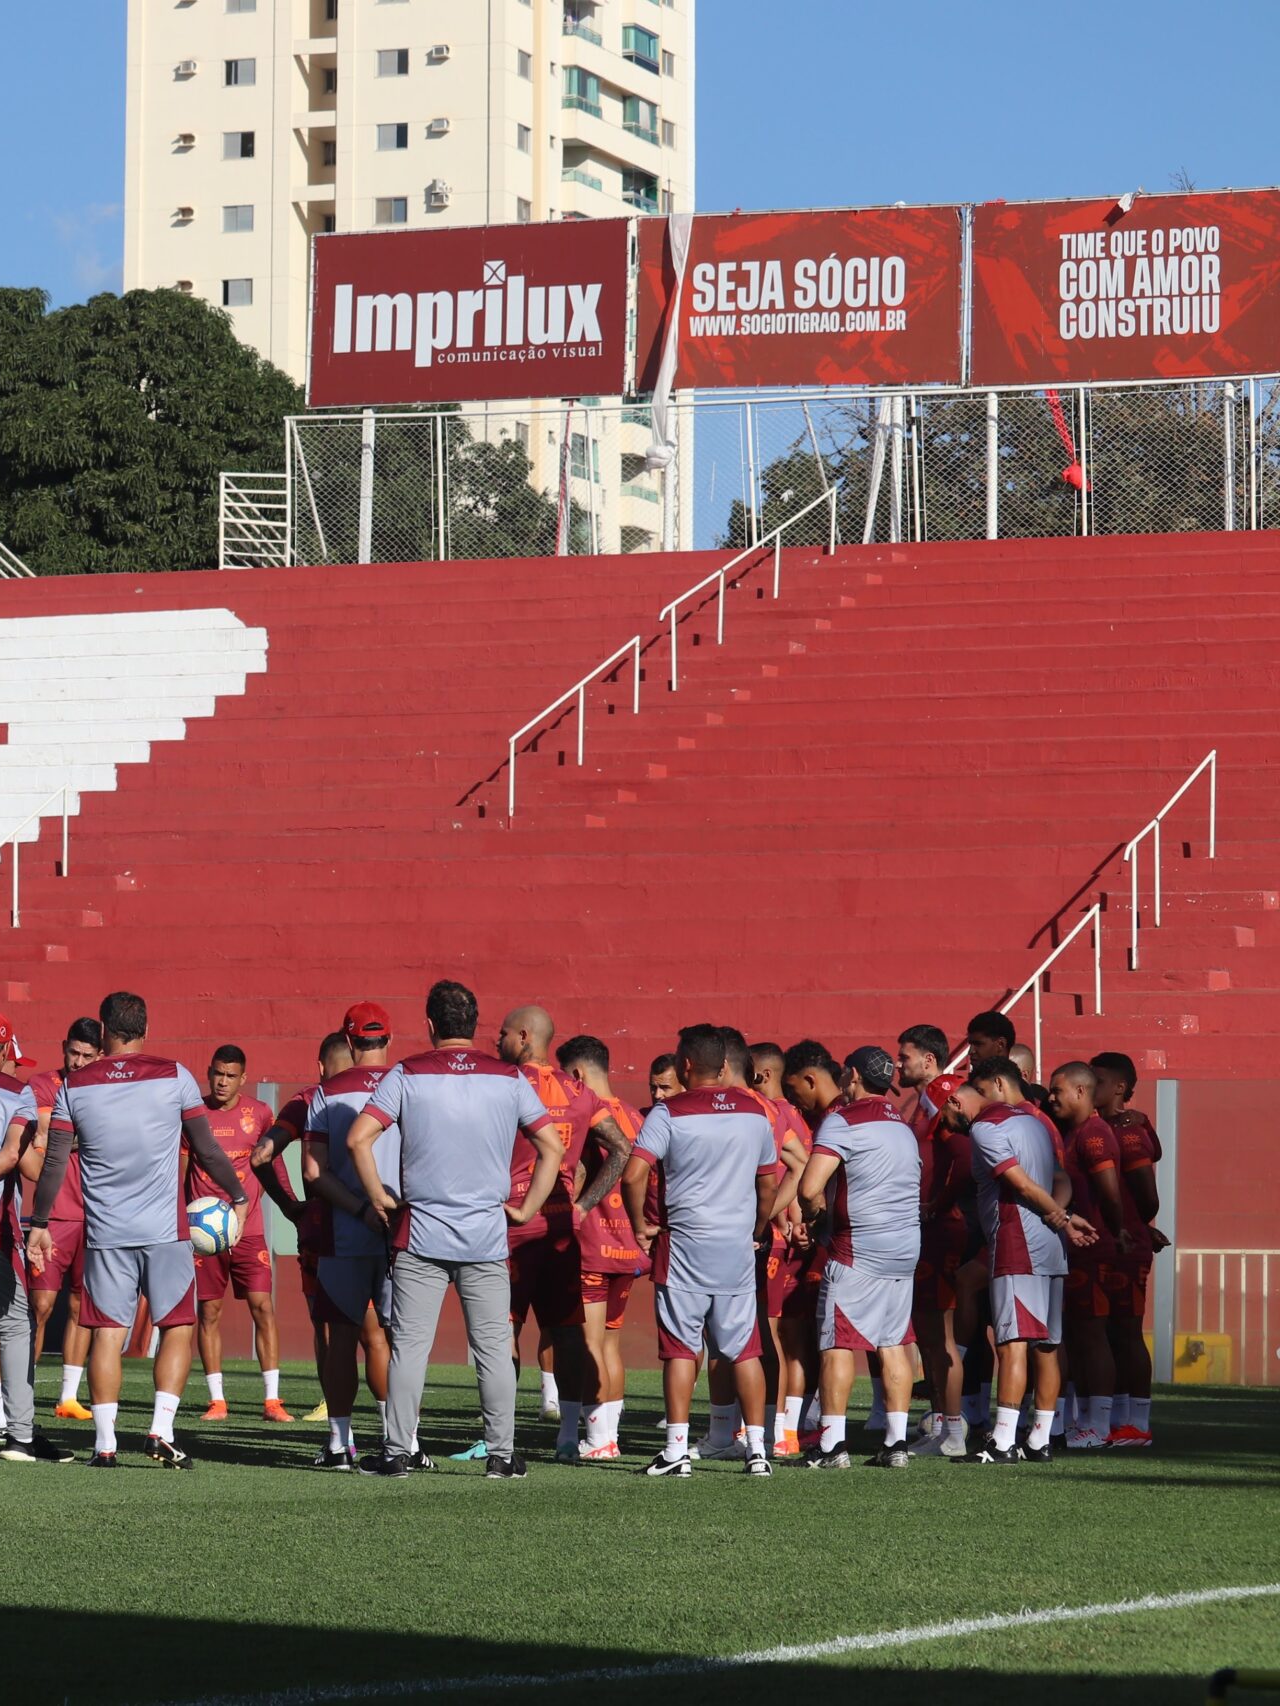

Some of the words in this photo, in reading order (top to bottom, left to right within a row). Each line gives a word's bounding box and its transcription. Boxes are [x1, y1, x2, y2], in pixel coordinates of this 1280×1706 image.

[1059, 232, 1106, 260] TIME
[1110, 230, 1147, 259] QUE
[1151, 229, 1164, 255] O
[1169, 226, 1219, 254] POVO
[692, 260, 785, 312] SEJA
[793, 252, 906, 309] SÓCIO
[1059, 258, 1125, 300] COM
[1132, 254, 1220, 297] AMOR
[333, 260, 602, 367] Imprilux
[689, 310, 906, 337] WWW.SOCIOTIGRAO.COM.BR
[1059, 295, 1220, 340] CONSTRUIU
[437, 346, 546, 364] comunicação
[552, 342, 603, 359] visual
[105, 1070, 135, 1080] VOLT
[447, 1062, 477, 1071] VOLT
[363, 1080, 380, 1089] VO
[711, 1102, 737, 1111] VOLT
[600, 1244, 641, 1260] Unime
